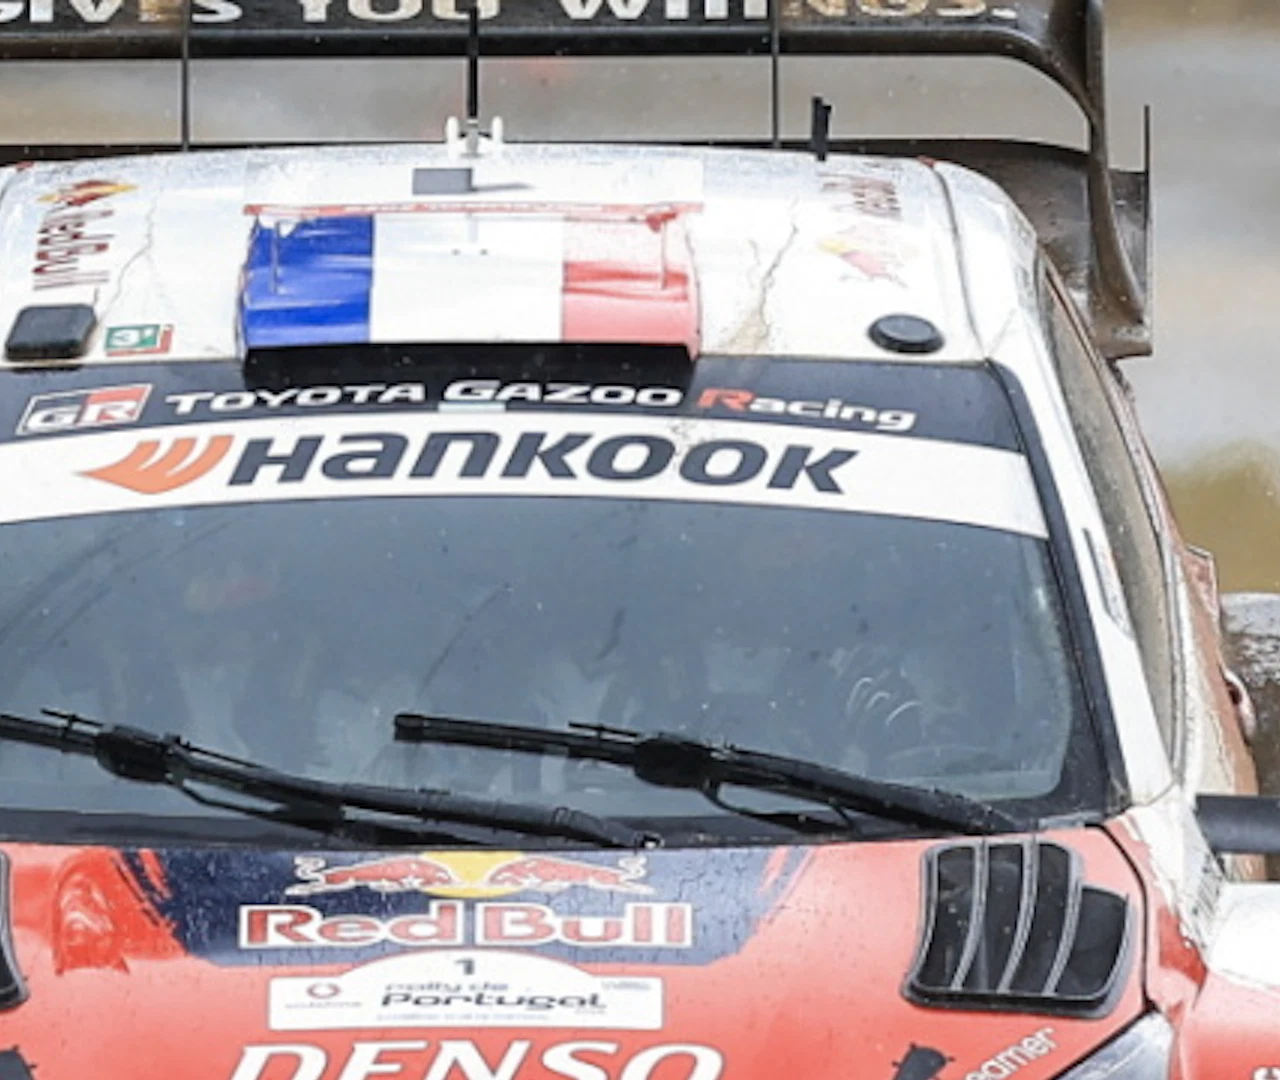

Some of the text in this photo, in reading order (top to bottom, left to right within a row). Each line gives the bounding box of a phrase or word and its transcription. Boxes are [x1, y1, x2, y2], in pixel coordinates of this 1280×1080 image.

[164, 382, 426, 415] TOYOTA
[444, 379, 683, 406] GAZOO
[698, 387, 918, 431] Racing
[240, 901, 692, 947] Red Bull
[454, 957, 476, 976] 1
[381, 991, 608, 1011] Portugal
